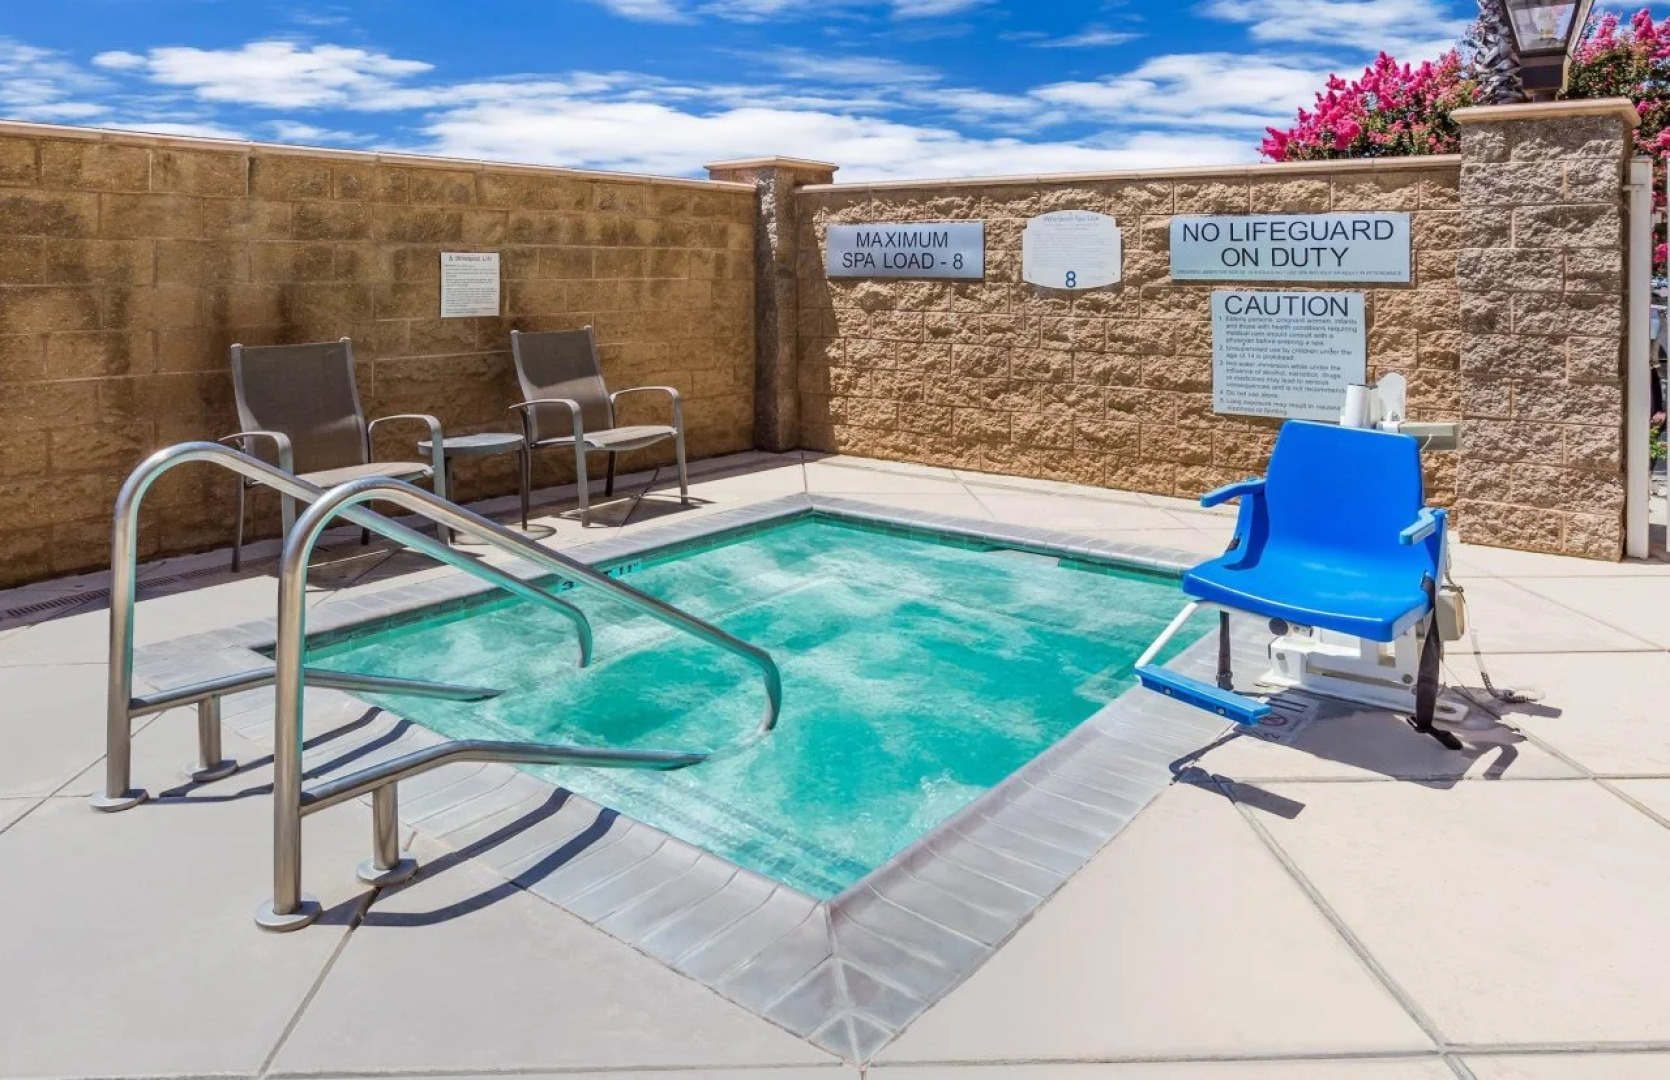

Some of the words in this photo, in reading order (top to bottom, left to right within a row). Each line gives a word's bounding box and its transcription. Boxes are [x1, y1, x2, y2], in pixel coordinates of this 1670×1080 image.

[856, 231, 948, 249] MAXIMUM
[1183, 222, 1220, 242] NO
[1230, 220, 1394, 242] LIFEGUARD
[842, 253, 875, 268] SPA
[884, 253, 934, 269] LOAD
[953, 253, 963, 270] 8
[1221, 247, 1259, 267] ON
[1271, 247, 1349, 266] DUTY
[1065, 270, 1076, 288] 8
[1225, 295, 1348, 317] CAUTION
